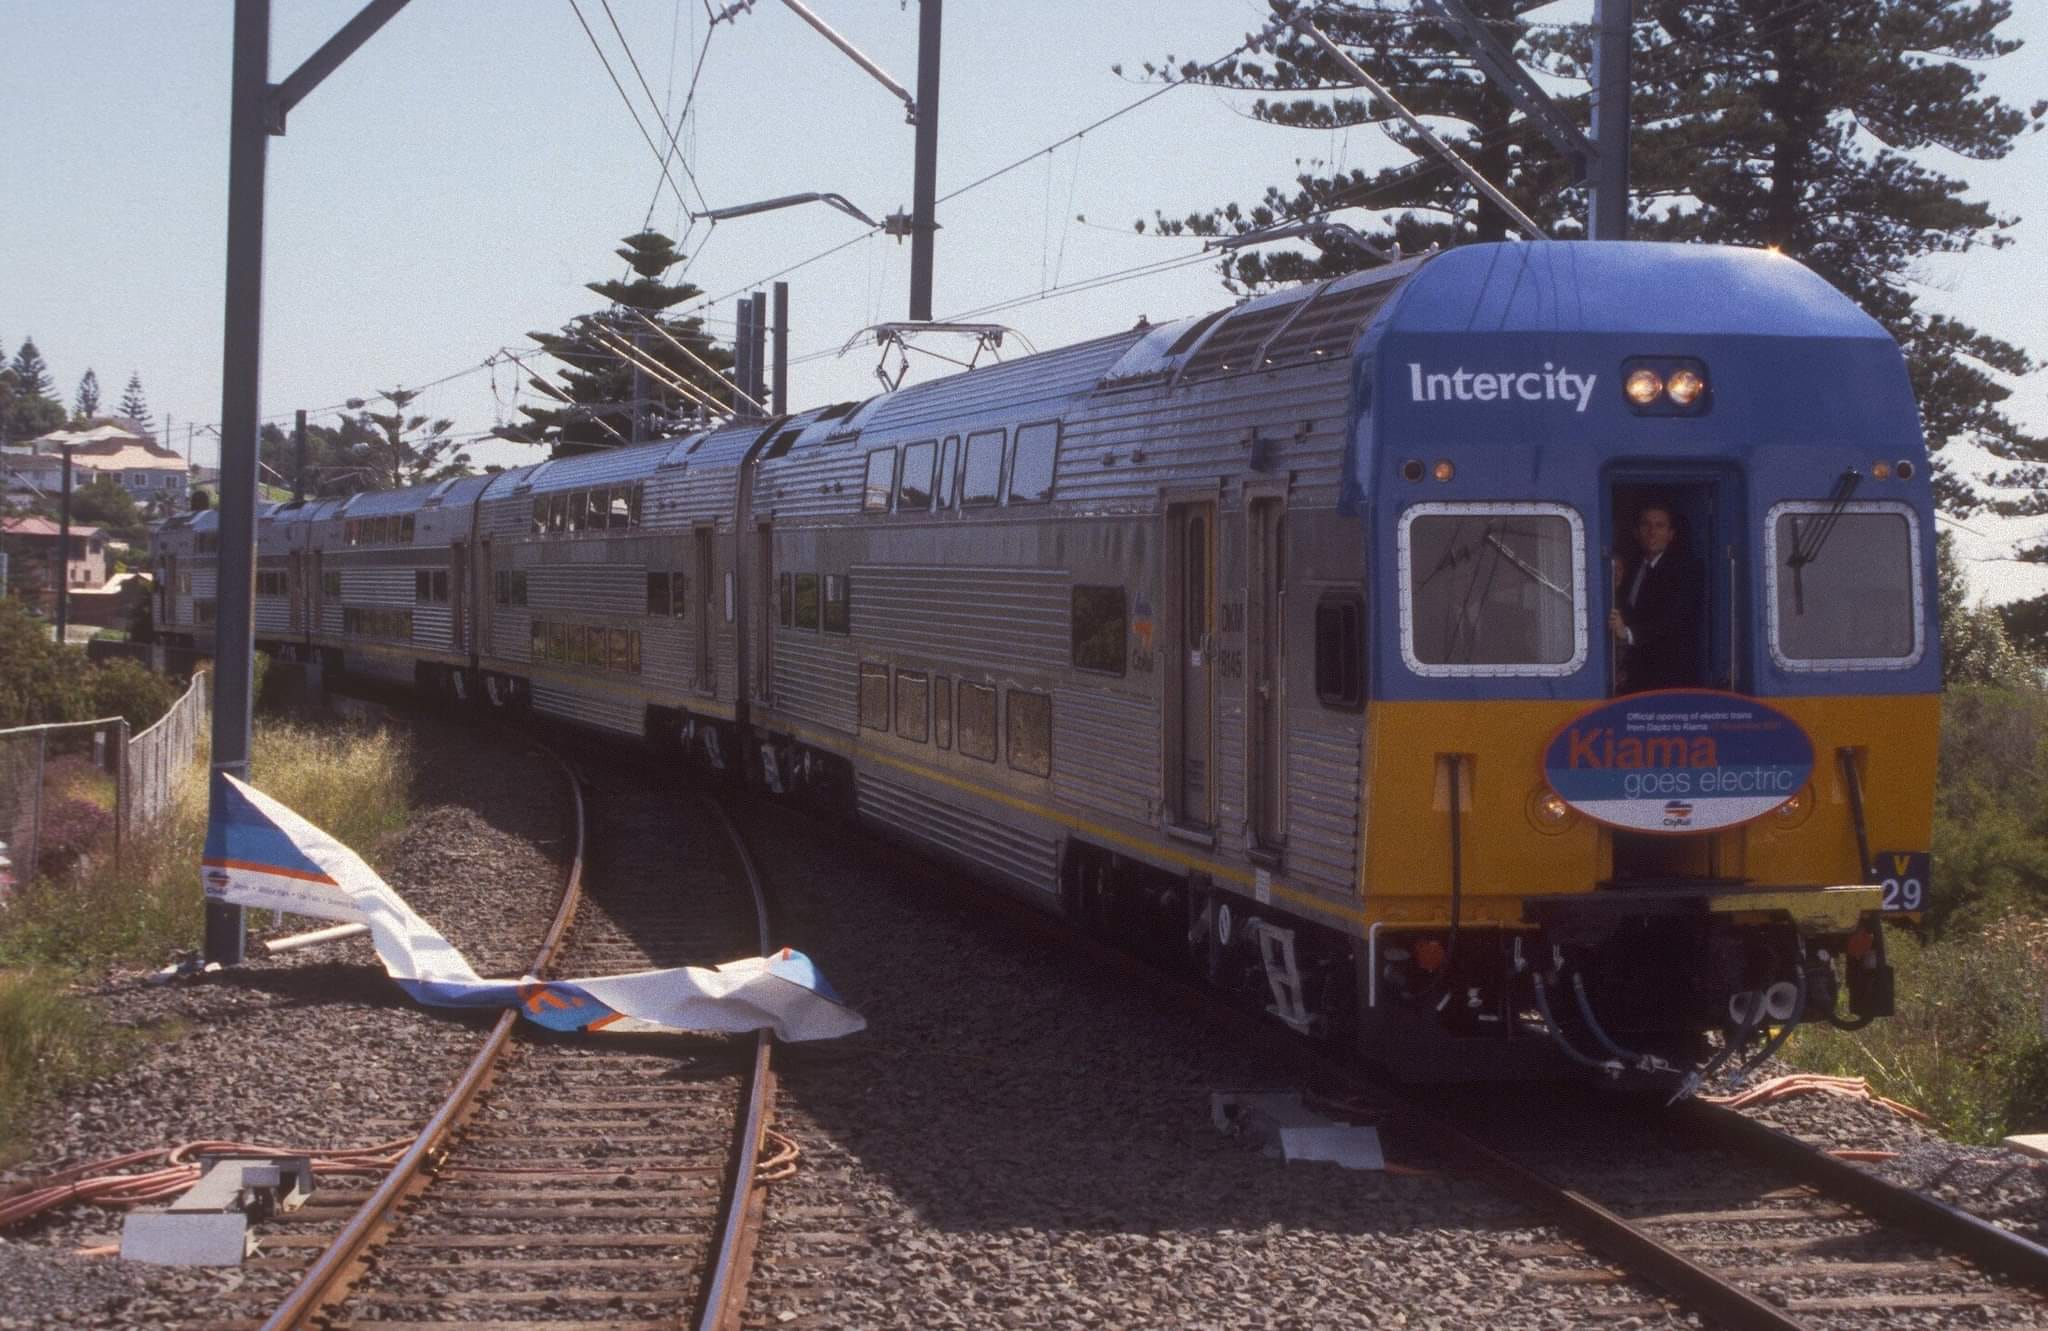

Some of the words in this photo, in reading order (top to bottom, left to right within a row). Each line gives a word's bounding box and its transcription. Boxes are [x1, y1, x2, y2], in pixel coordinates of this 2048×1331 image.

[1408, 362, 1598, 412] Intercity
[1626, 712, 1655, 721] Official
[1656, 713, 1688, 722] opening
[1690, 712, 1699, 721] of
[1700, 711, 1729, 720] electric
[1730, 711, 1752, 719] trains
[1626, 723, 1645, 731] from
[1673, 723, 1681, 731] to
[1683, 723, 1708, 731] Kiama
[1569, 729, 1718, 768] Kiama
[1624, 772, 1690, 798] goes
[1700, 765, 1793, 792] electric
[1893, 855, 1911, 876] V
[1881, 878, 1921, 910] 29
